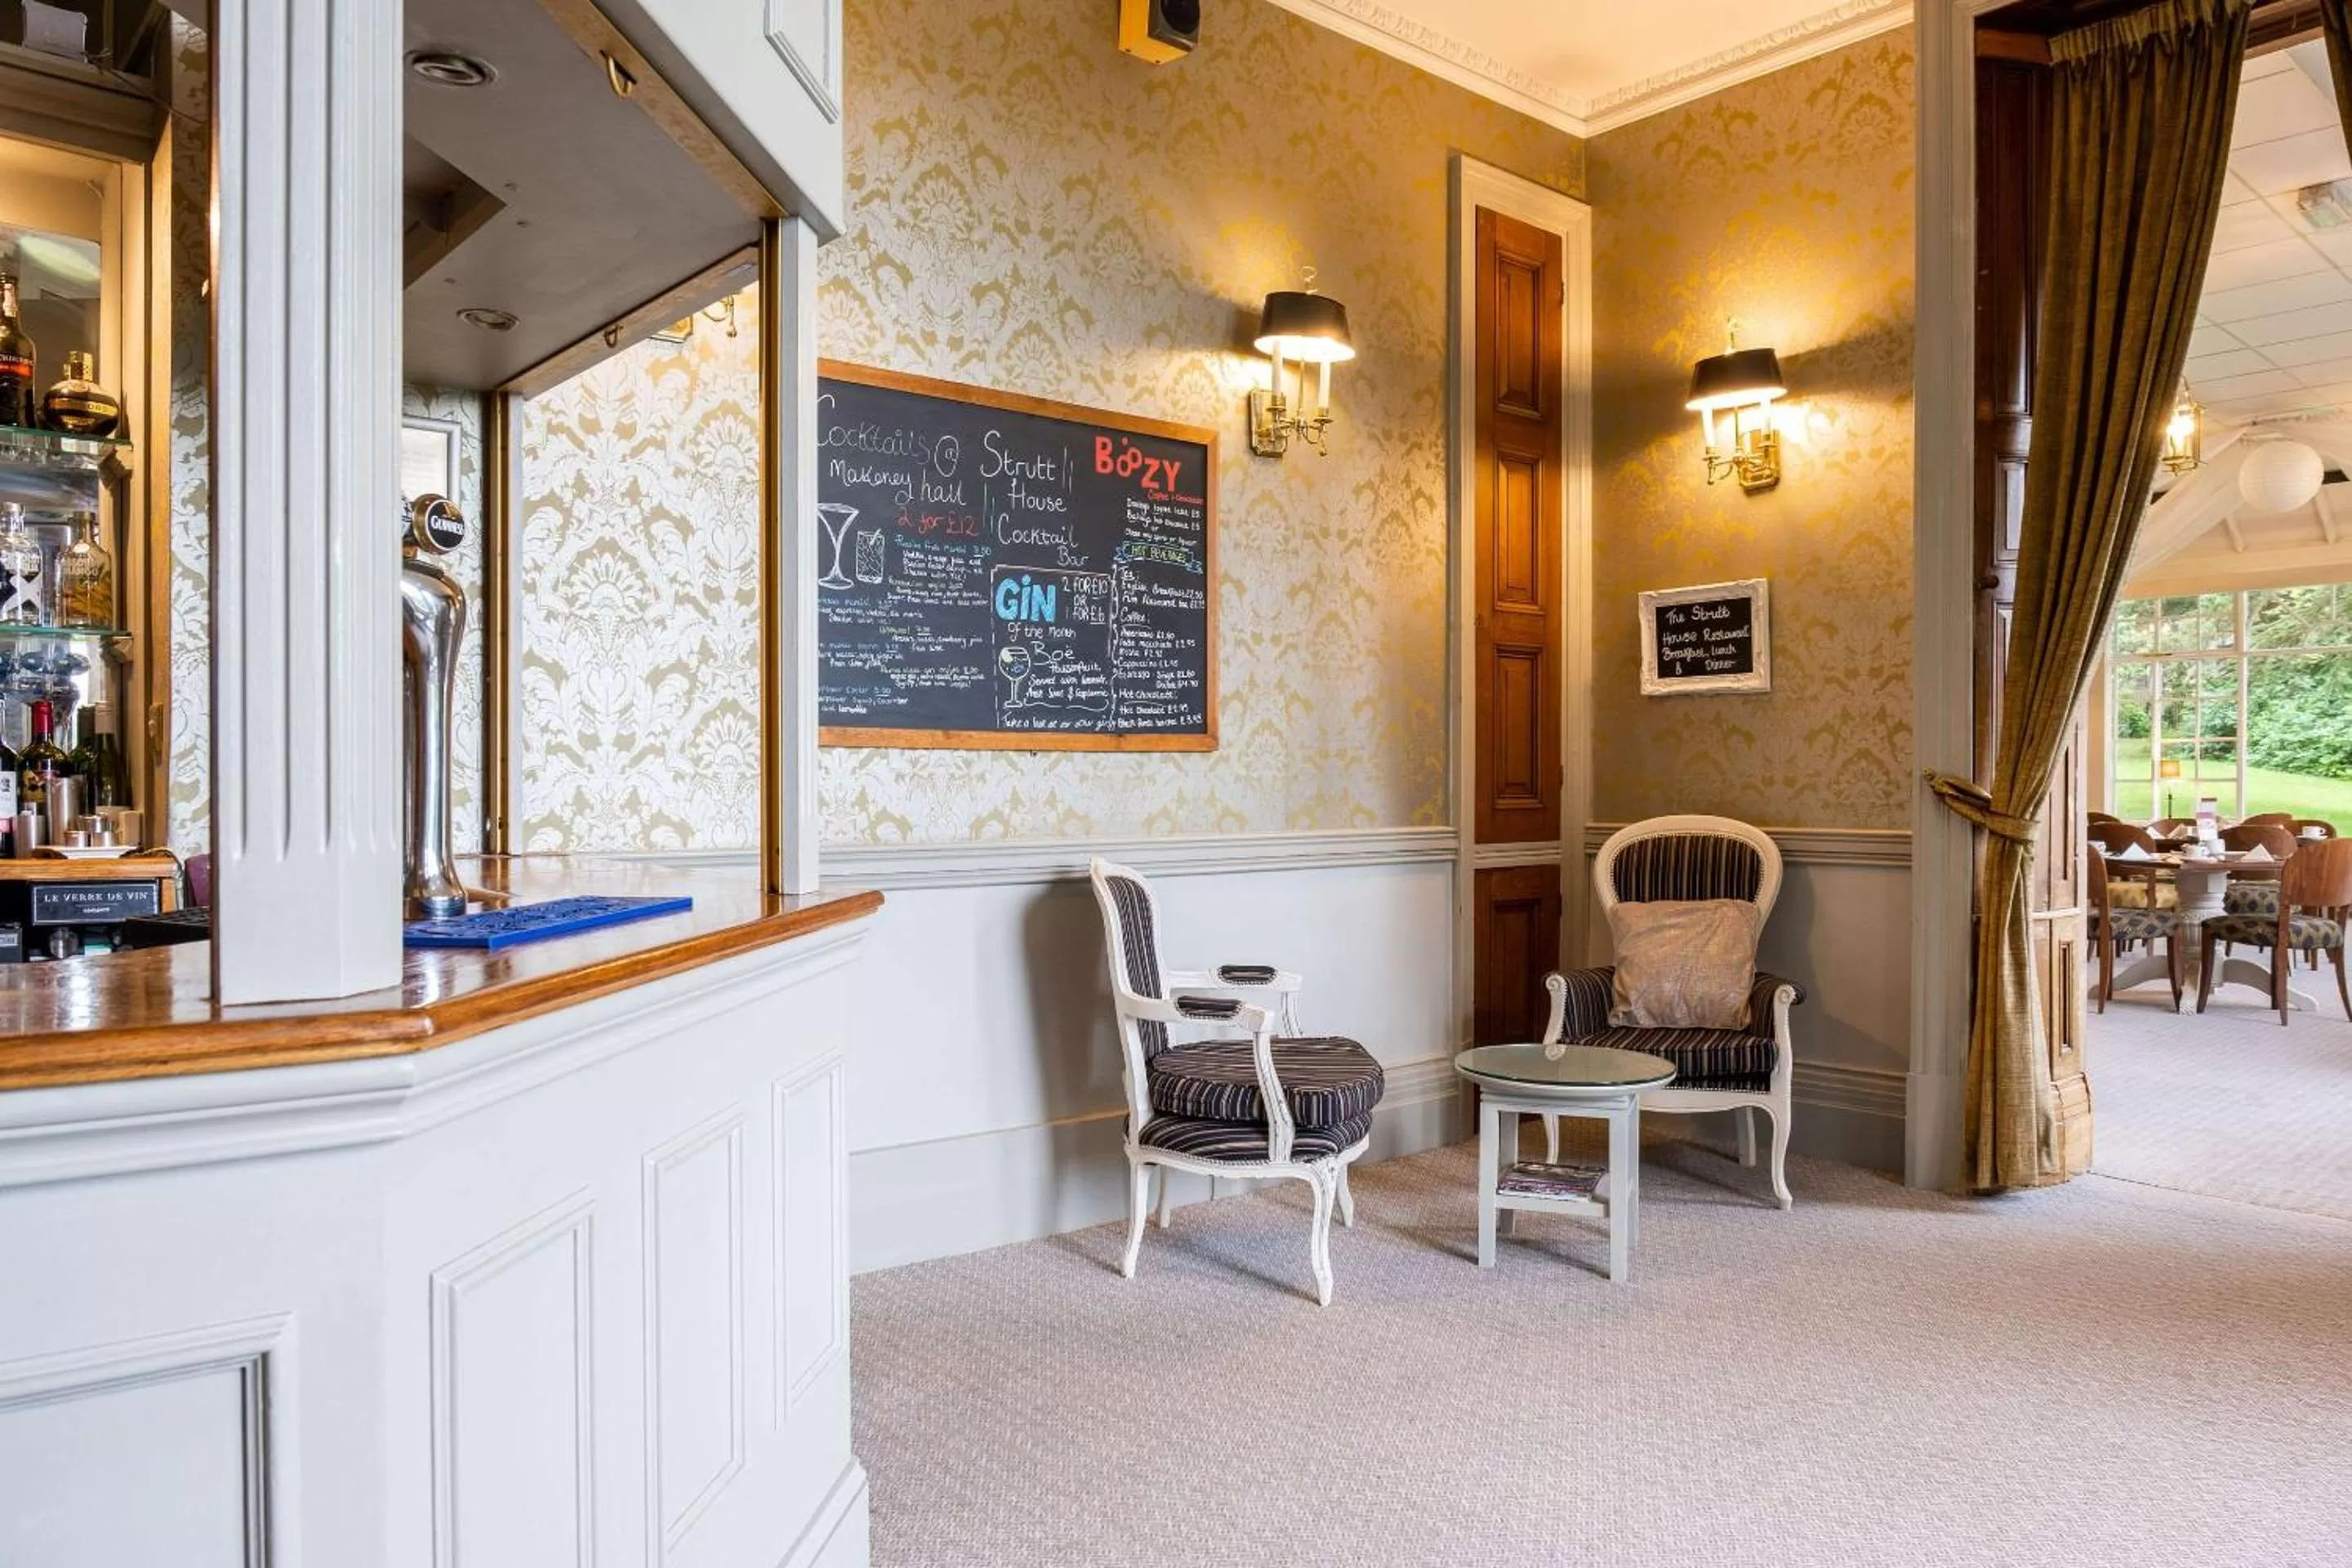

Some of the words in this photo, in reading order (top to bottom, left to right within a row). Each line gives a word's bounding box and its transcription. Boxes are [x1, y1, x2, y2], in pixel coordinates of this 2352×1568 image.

[934, 434, 960, 477] @
[980, 430, 1056, 477] Strutt
[920, 467, 967, 506] hall
[1007, 477, 1067, 511] House
[998, 512, 1079, 549] Cocktail
[1058, 546, 1089, 567] Bar
[1062, 576, 1071, 592] 2
[1665, 608, 1686, 626] The
[44, 894, 60, 902] LE
[63, 893, 104, 902] VERRE
[107, 892, 123, 900] DE
[127, 891, 148, 900] VIN
